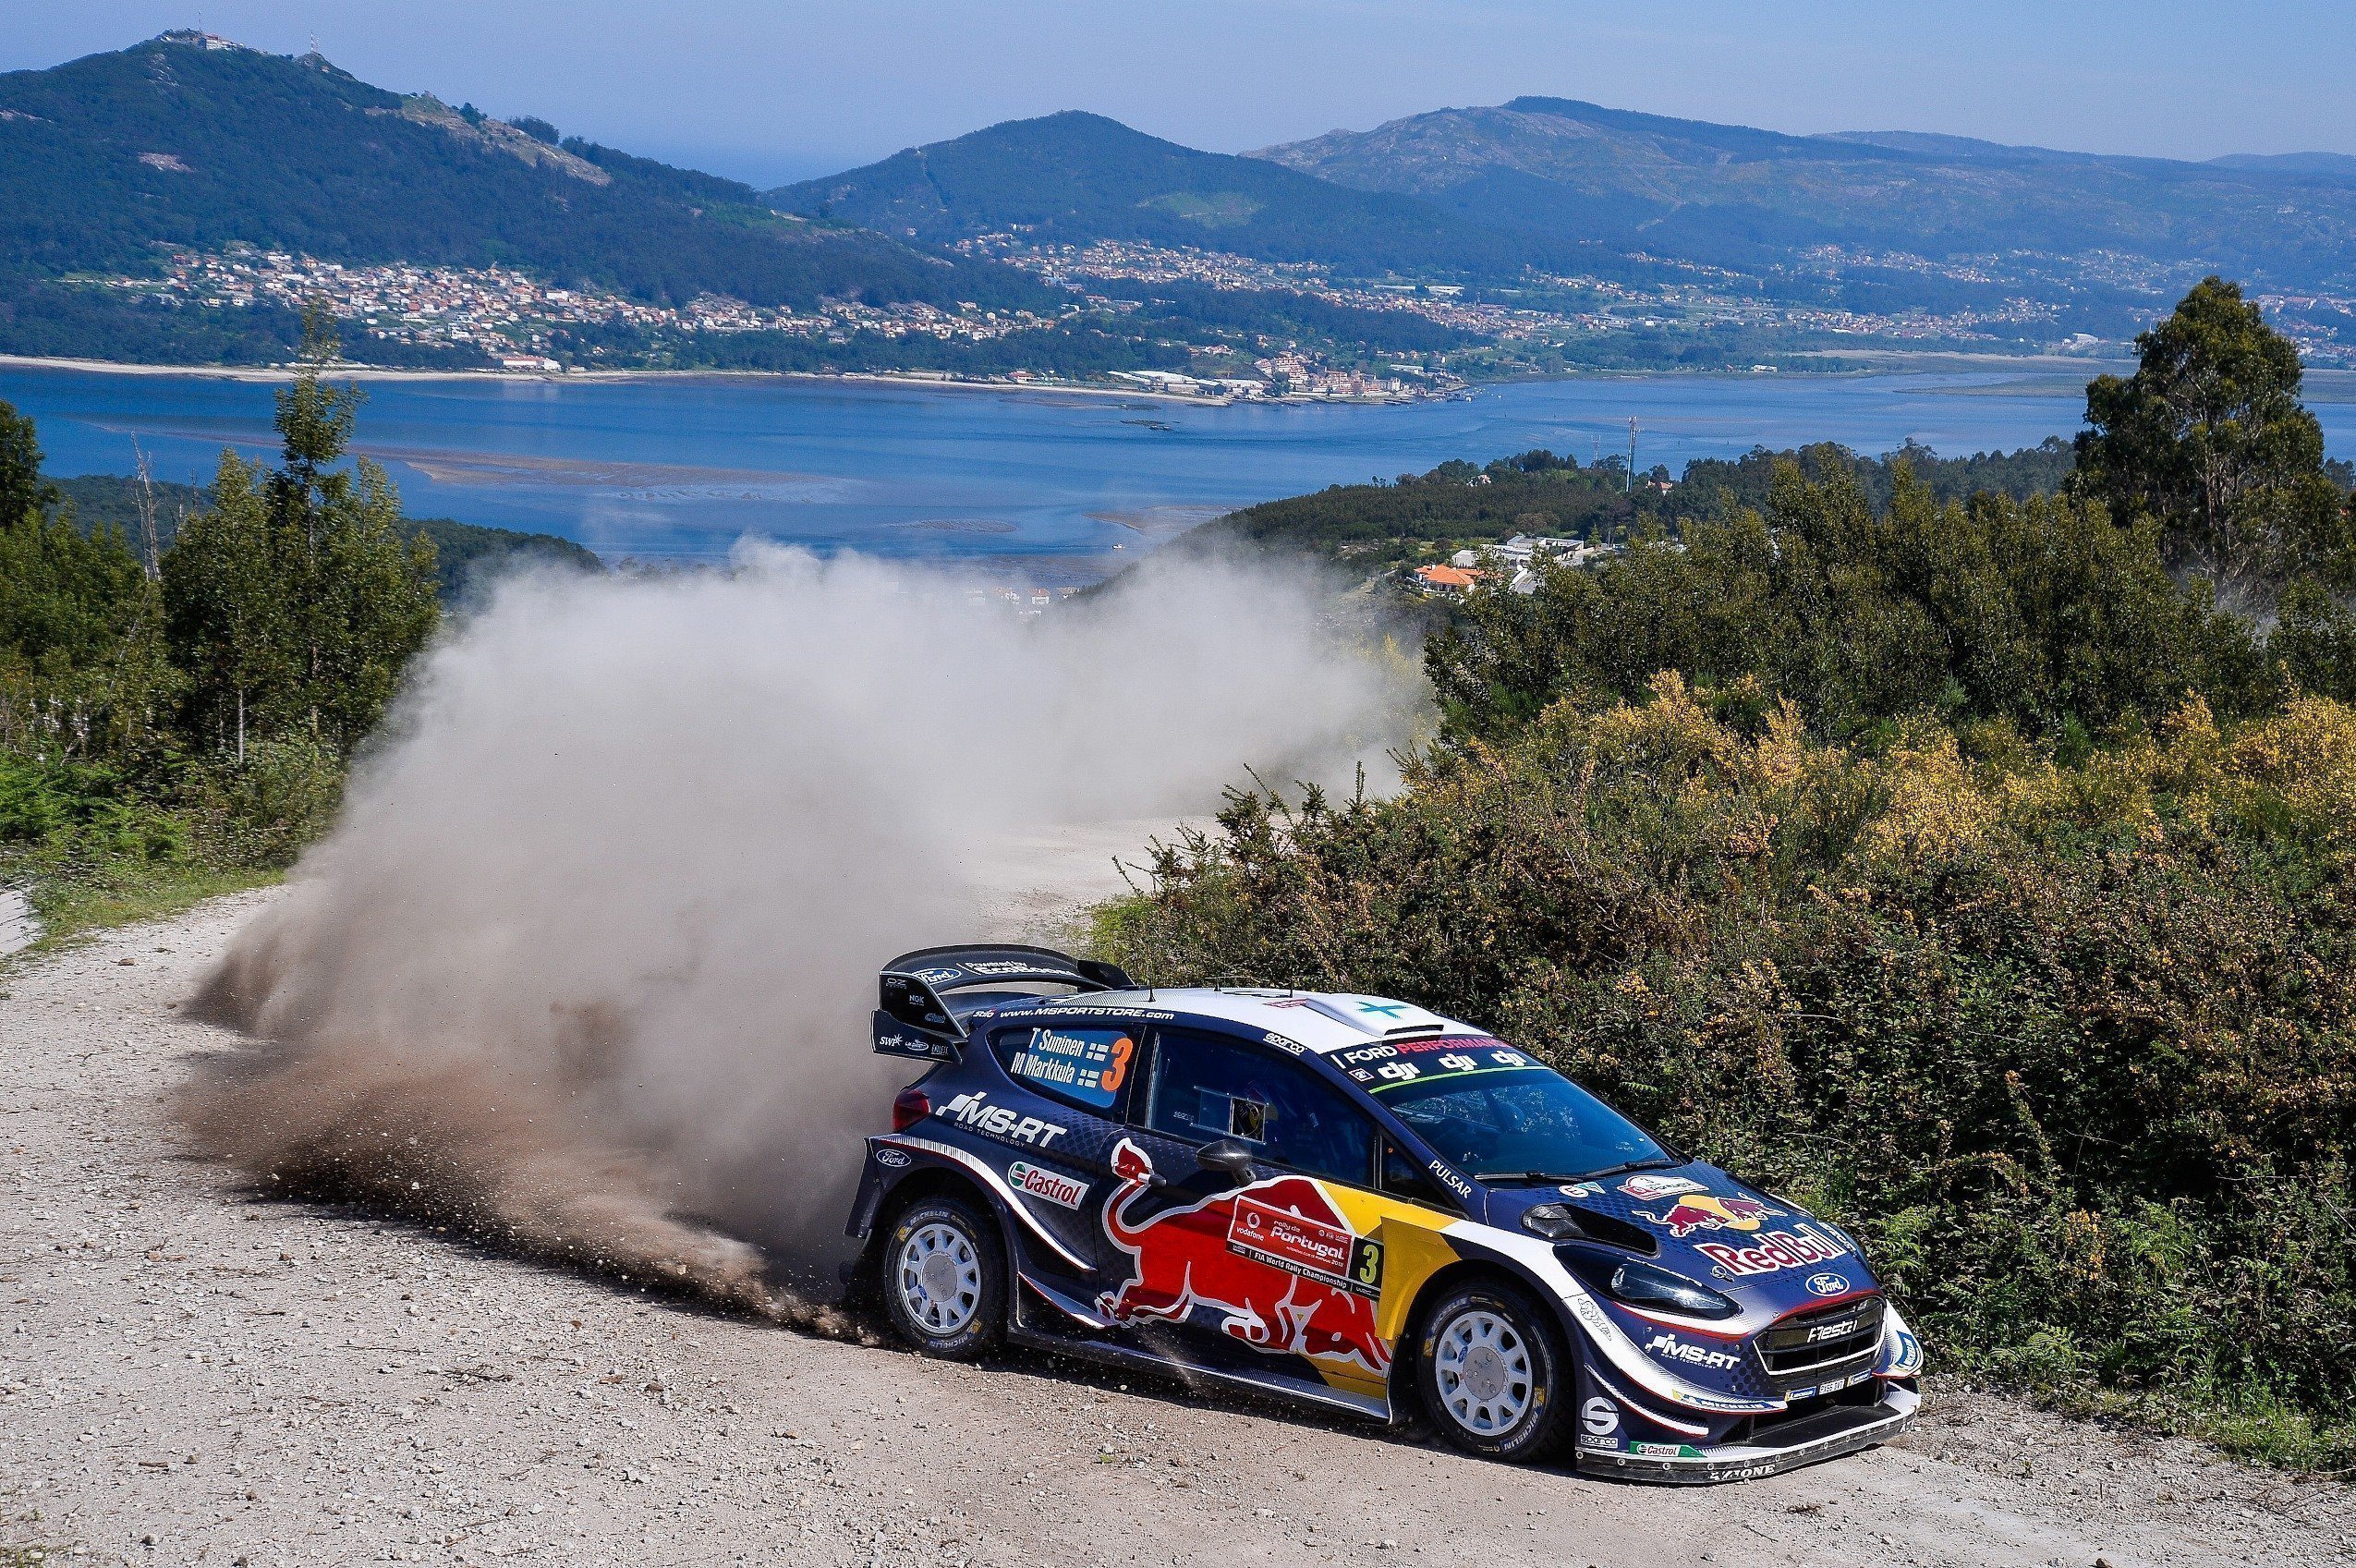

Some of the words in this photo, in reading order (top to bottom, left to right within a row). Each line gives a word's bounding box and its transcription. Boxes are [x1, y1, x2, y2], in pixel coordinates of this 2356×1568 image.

[887, 978, 906, 986] OZ
[909, 995, 925, 1003] NGK
[1000, 1007, 1174, 1020] www.MSPORTSTORE.com
[1029, 1027, 1040, 1048] T
[1038, 1029, 1085, 1058] Suninen
[1265, 1033, 1306, 1053] sparco
[1343, 1045, 1398, 1064] FORD
[1010, 1051, 1026, 1075] M
[1023, 1053, 1075, 1085] Markkula
[1101, 1038, 1134, 1092] 3
[953, 1122, 974, 1133] ROAD
[977, 1128, 1026, 1148] TECHNOLOGY
[881, 1150, 905, 1165] Ford
[1025, 1170, 1082, 1205] Castrol
[1428, 1160, 1472, 1199] PULSAR
[1236, 1226, 1265, 1242] vodafone
[1273, 1220, 1292, 1231] rally
[1269, 1225, 1345, 1261] Portugal
[1254, 1252, 1266, 1262] FIA
[1266, 1256, 1285, 1269] World
[1285, 1263, 1303, 1275] Rally
[1303, 1269, 1347, 1289] Championship
[1359, 1245, 1379, 1284] 3
[1814, 1275, 1843, 1294] Ford
[1807, 1319, 1858, 1343] Fiesta
[1581, 1435, 1617, 1445] sparco
[1647, 1445, 1677, 1455] Castrol
